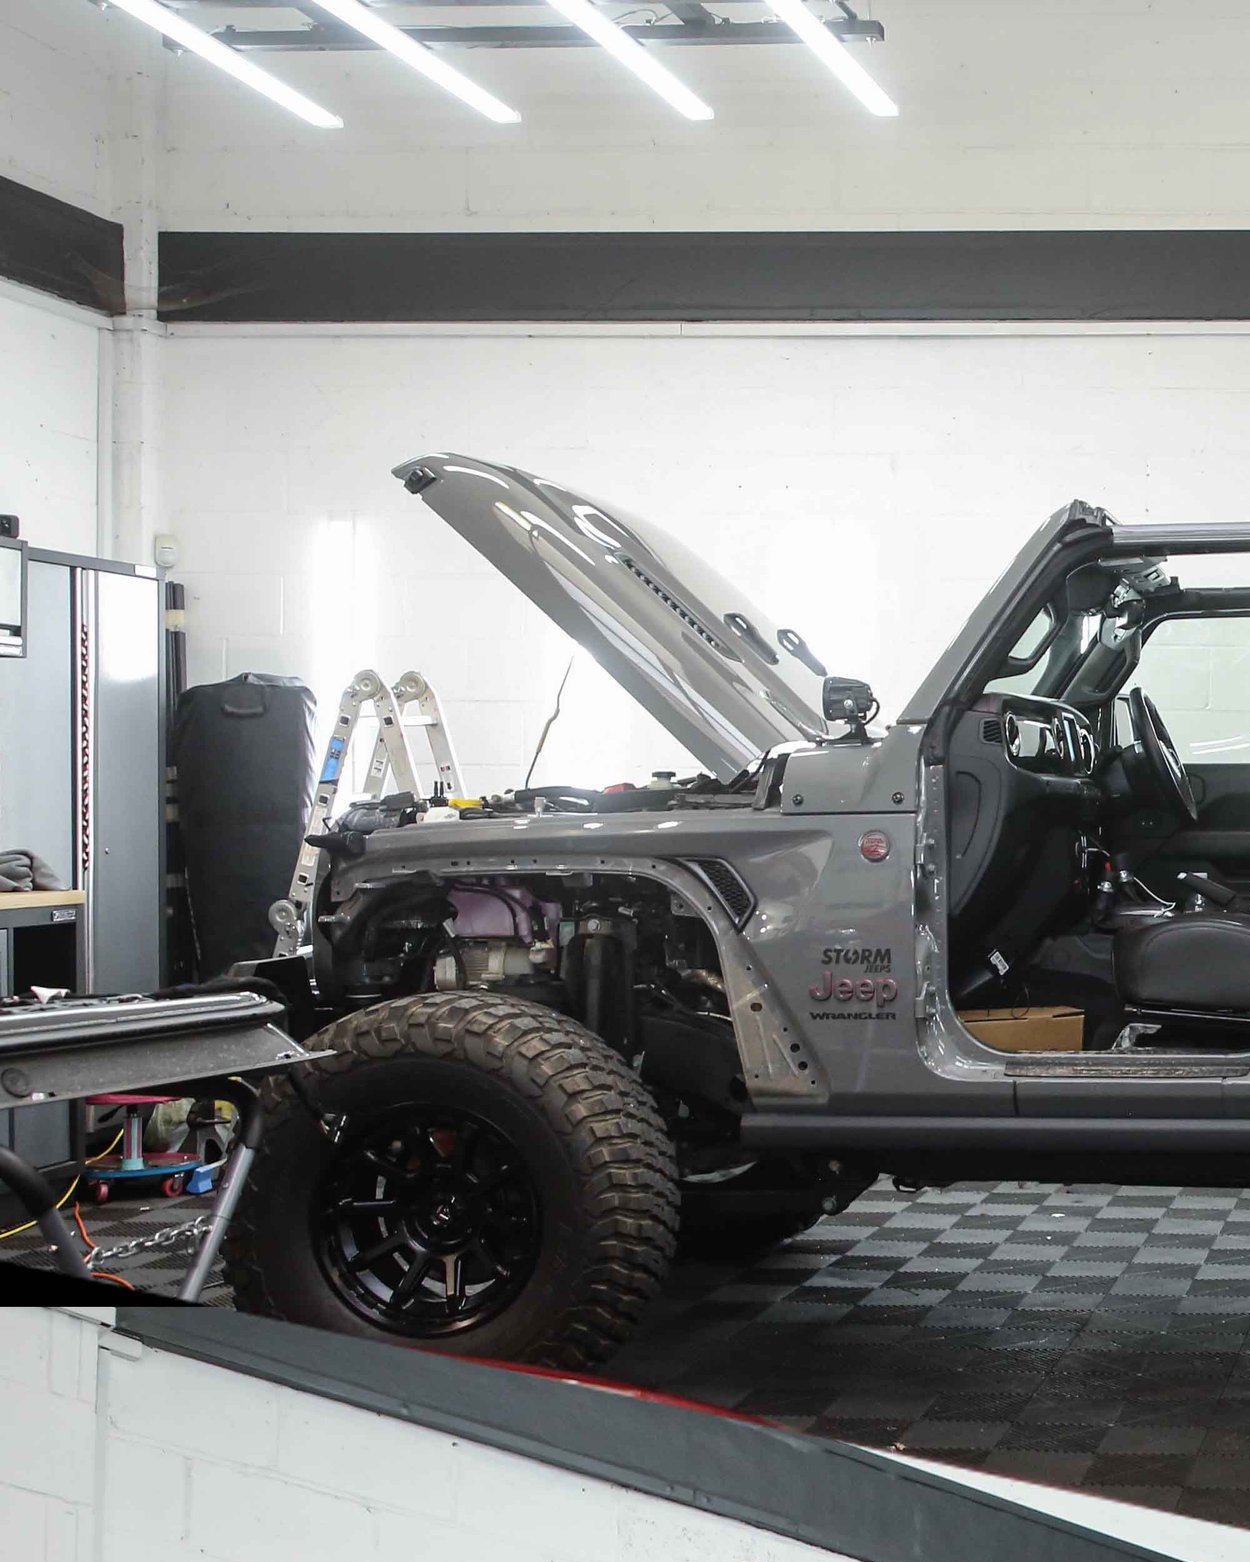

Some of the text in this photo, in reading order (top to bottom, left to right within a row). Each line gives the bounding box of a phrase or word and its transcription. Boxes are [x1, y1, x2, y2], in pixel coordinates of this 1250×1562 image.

[821, 948, 892, 965] STORM
[864, 965, 892, 974] JEEPS
[809, 971, 898, 1009] Jeep
[809, 1012, 897, 1020] WRANGLER
